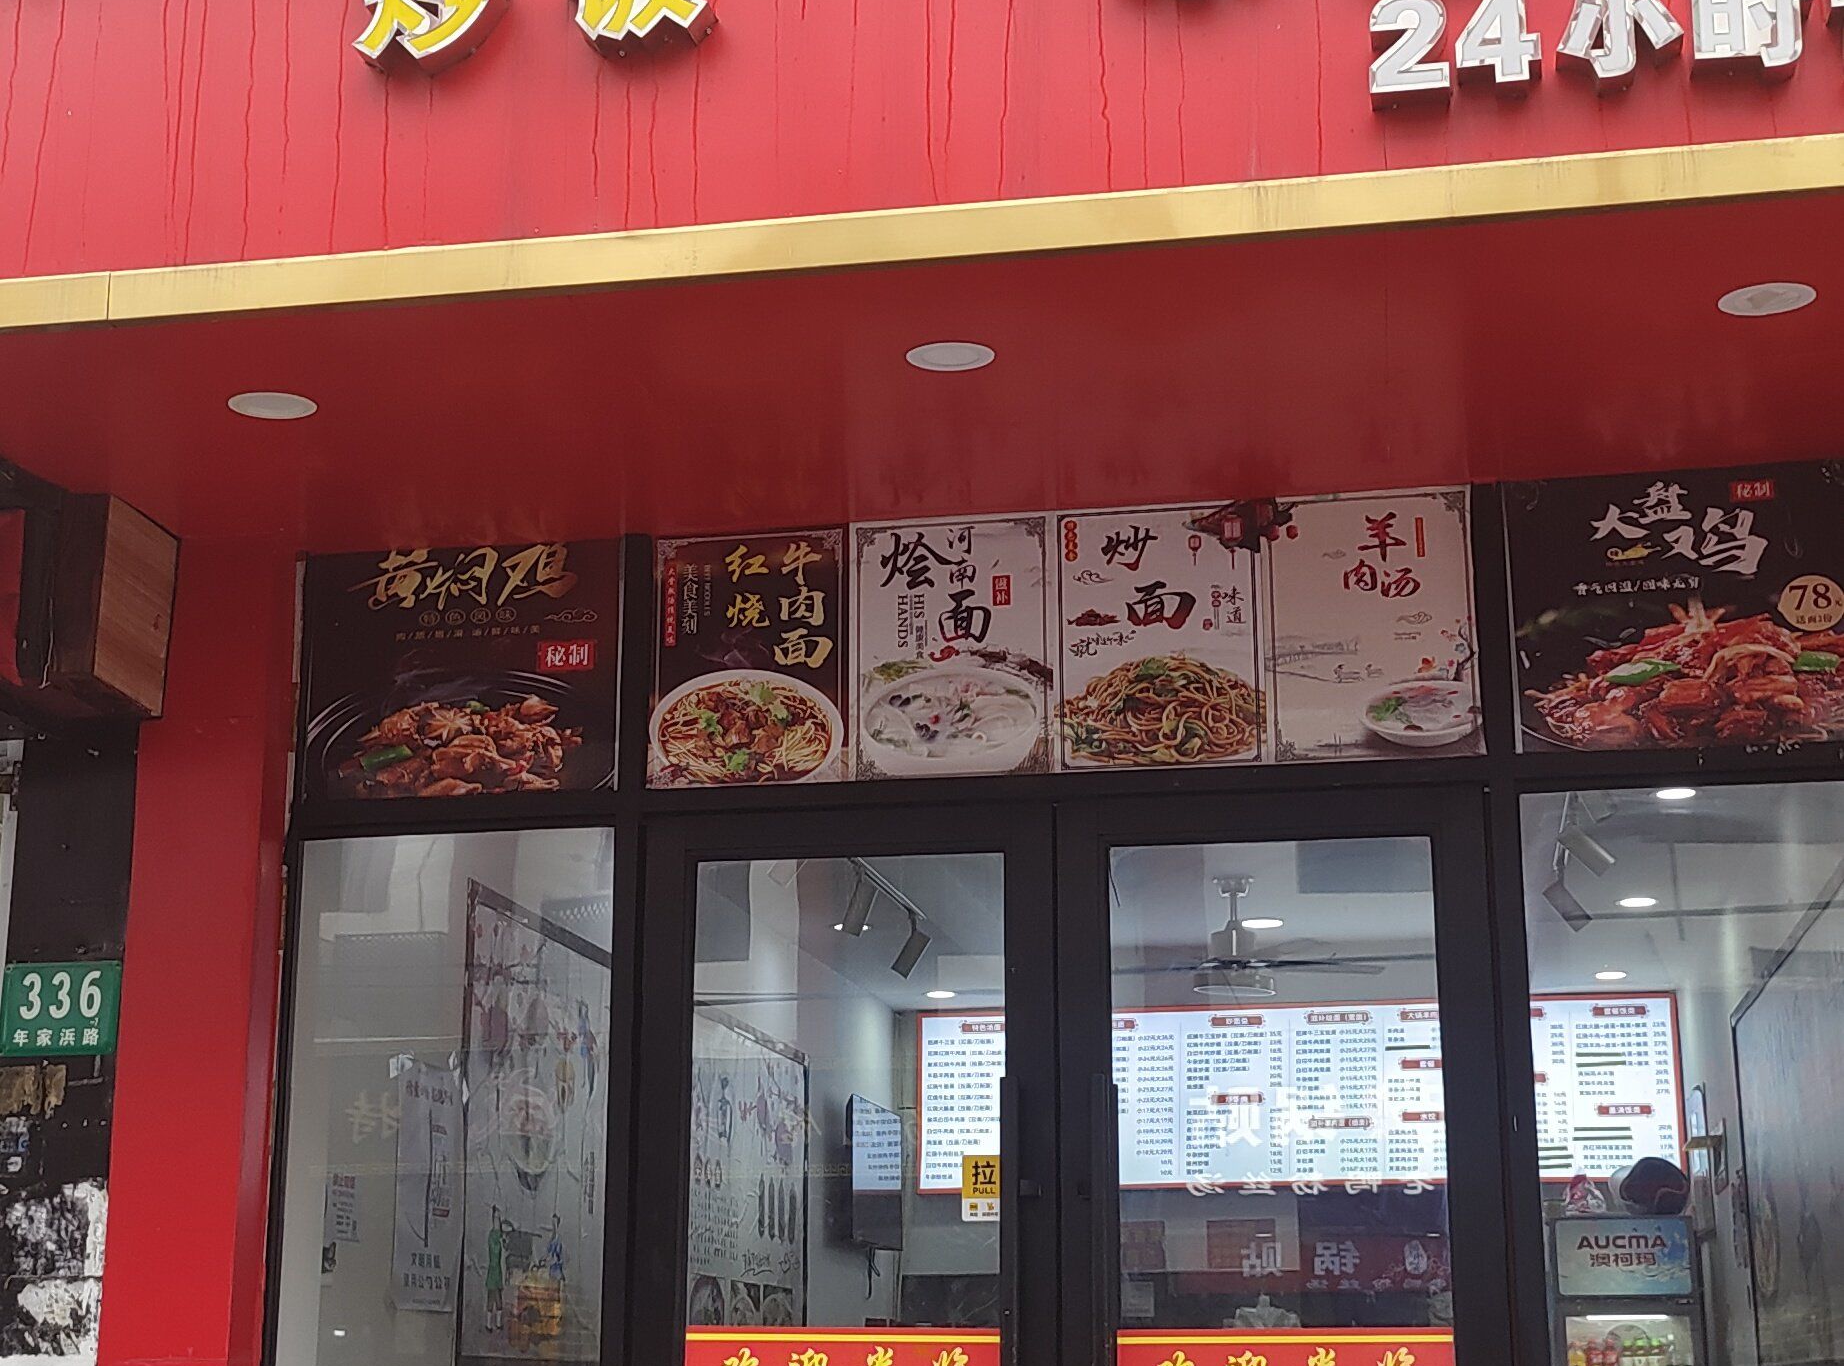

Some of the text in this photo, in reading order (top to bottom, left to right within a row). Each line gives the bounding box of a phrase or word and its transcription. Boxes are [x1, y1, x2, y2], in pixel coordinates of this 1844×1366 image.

[1590, 481, 1769, 575] 大盘鸡
[545, 643, 589, 668] 秘制
[19, 970, 102, 1021] 336
[13, 1027, 100, 1047] 年家浜路
[972, 1160, 997, 1186] 拉
[972, 1186, 997, 1195] PULL
[1576, 1235, 1668, 1251] AUCMA
[1589, 1252, 1657, 1268] 澳柯玛
